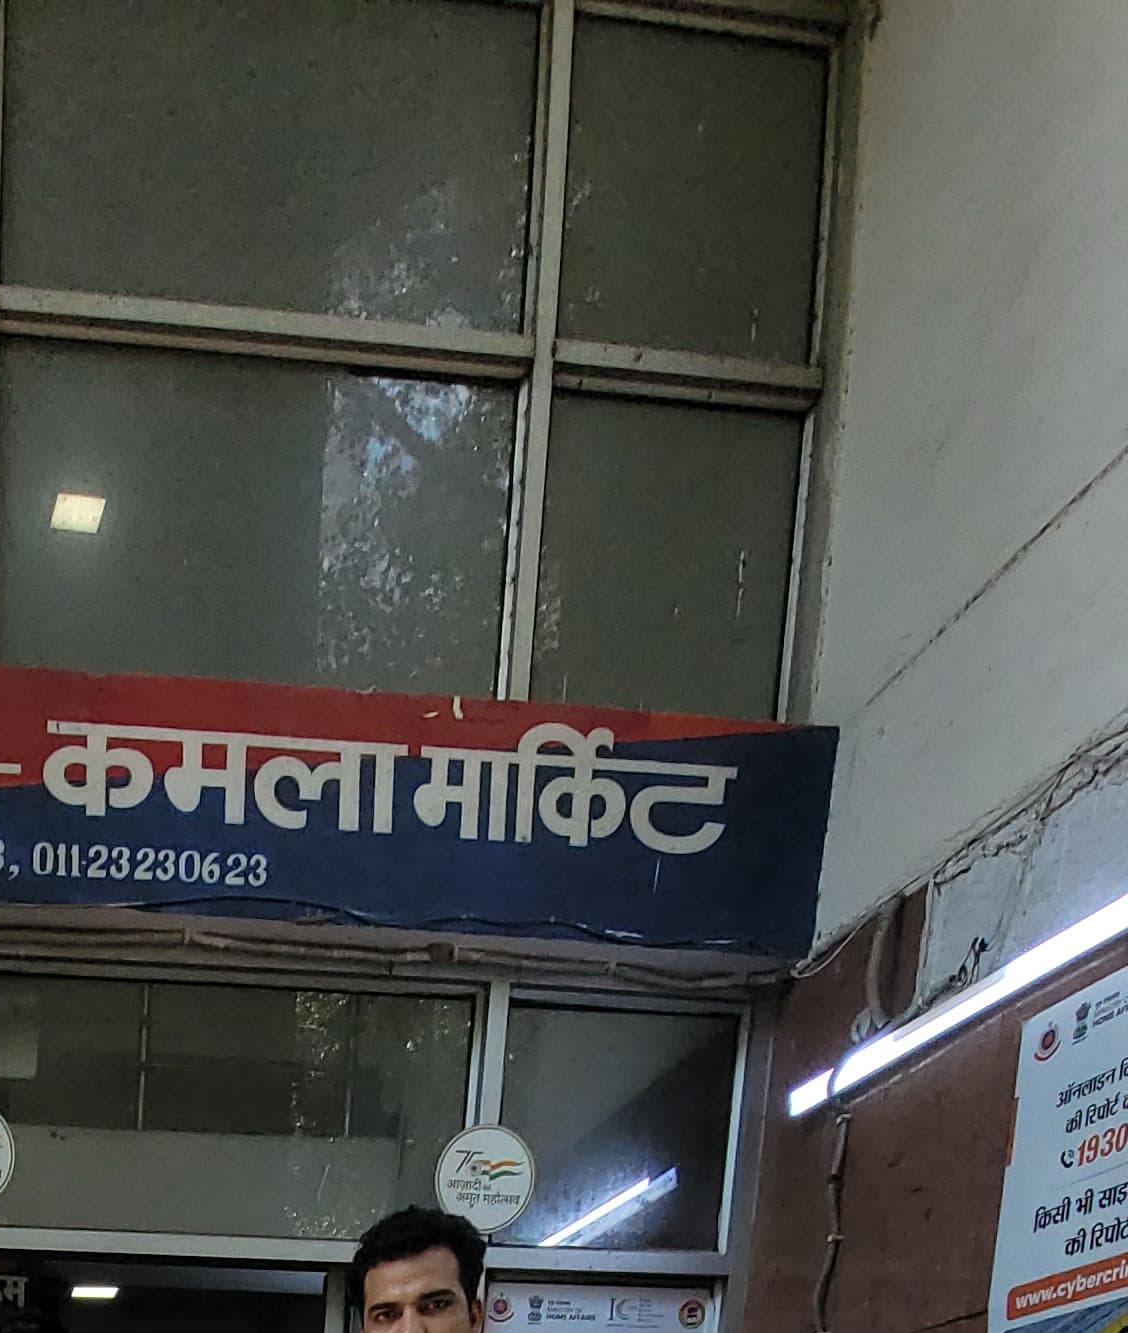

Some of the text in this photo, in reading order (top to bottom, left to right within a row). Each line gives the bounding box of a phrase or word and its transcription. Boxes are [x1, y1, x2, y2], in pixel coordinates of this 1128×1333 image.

[42, 719, 409, 835] कमला
[414, 722, 739, 856] मार्किट
[1056, 1067, 1117, 1108] ऑनलाइन
[1065, 1108, 1083, 1134] की
[1084, 1091, 1121, 1127] रिपोर्ट
[1077, 1122, 1128, 1167] 1930
[1033, 1196, 1071, 1234] किसी
[1075, 1188, 1095, 1216] भी
[1064, 1227, 1087, 1256] की
